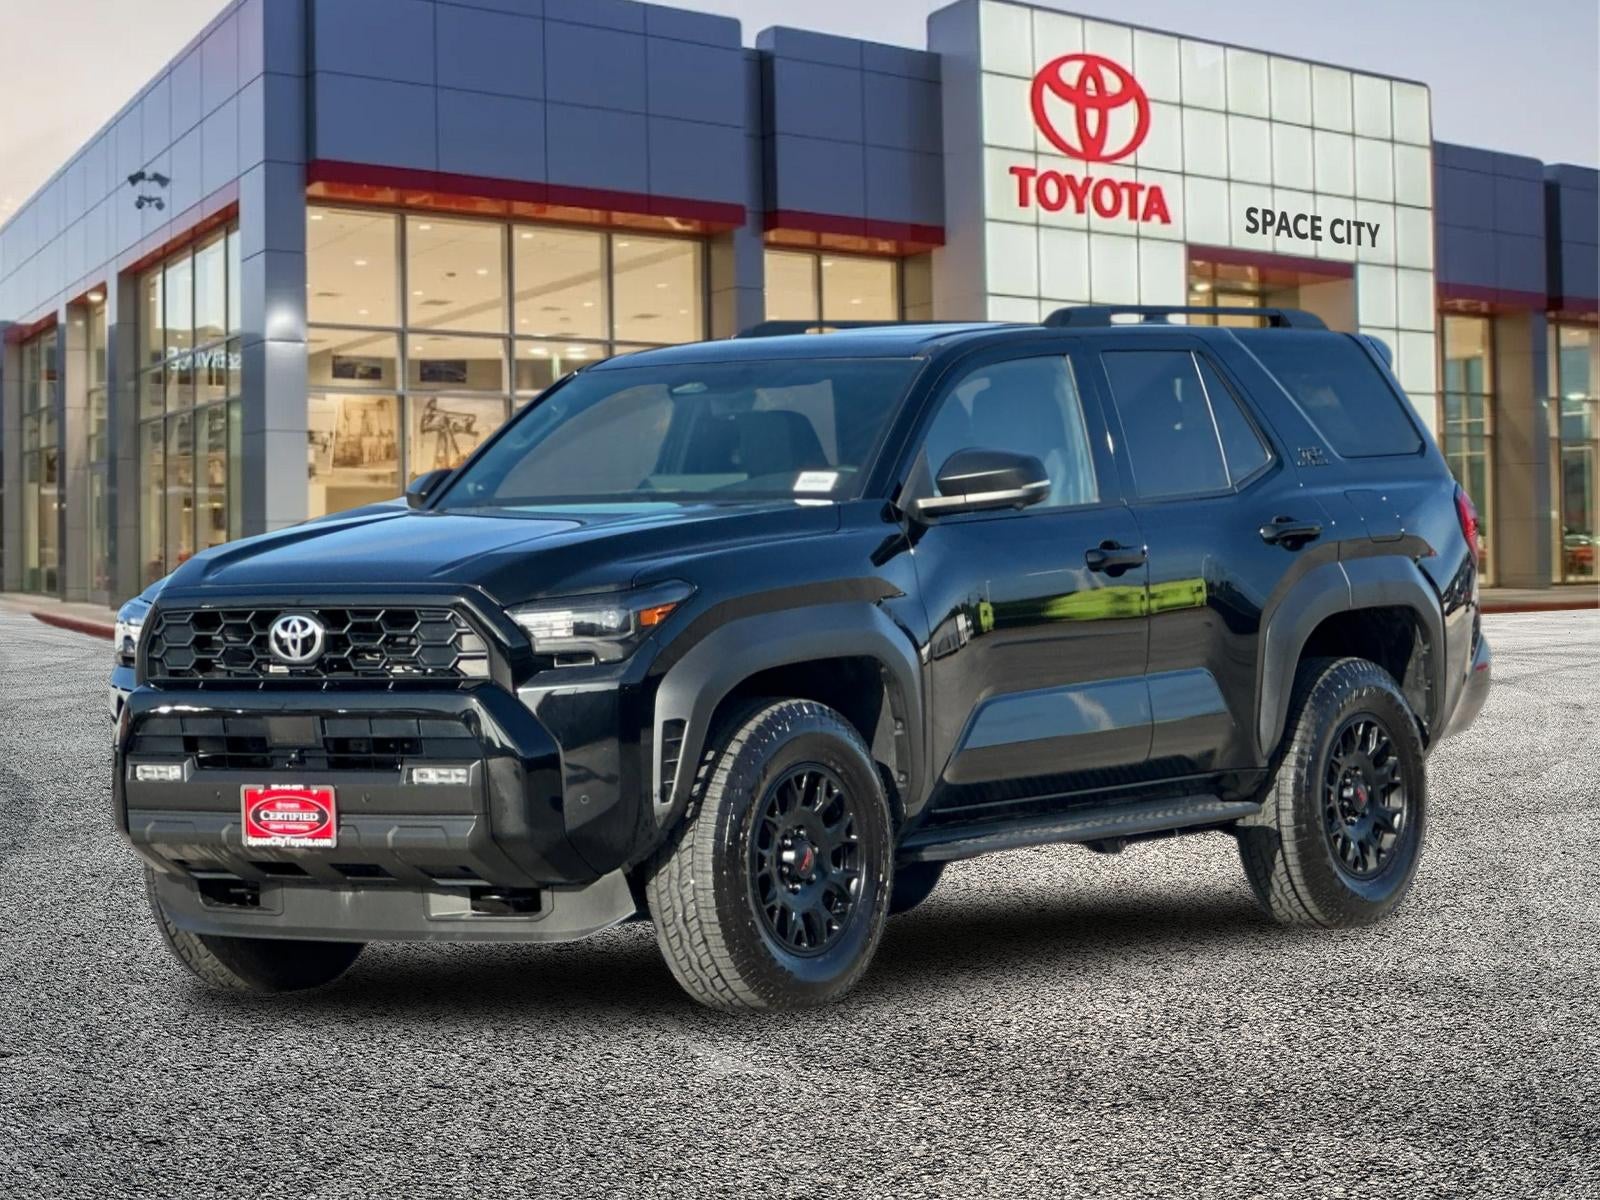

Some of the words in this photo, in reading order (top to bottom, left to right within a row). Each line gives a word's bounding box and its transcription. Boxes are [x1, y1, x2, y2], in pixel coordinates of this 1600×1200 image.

[1009, 166, 1171, 224] TOYOTA
[1245, 206, 1323, 241] SPACE
[1329, 218, 1381, 248] CITY
